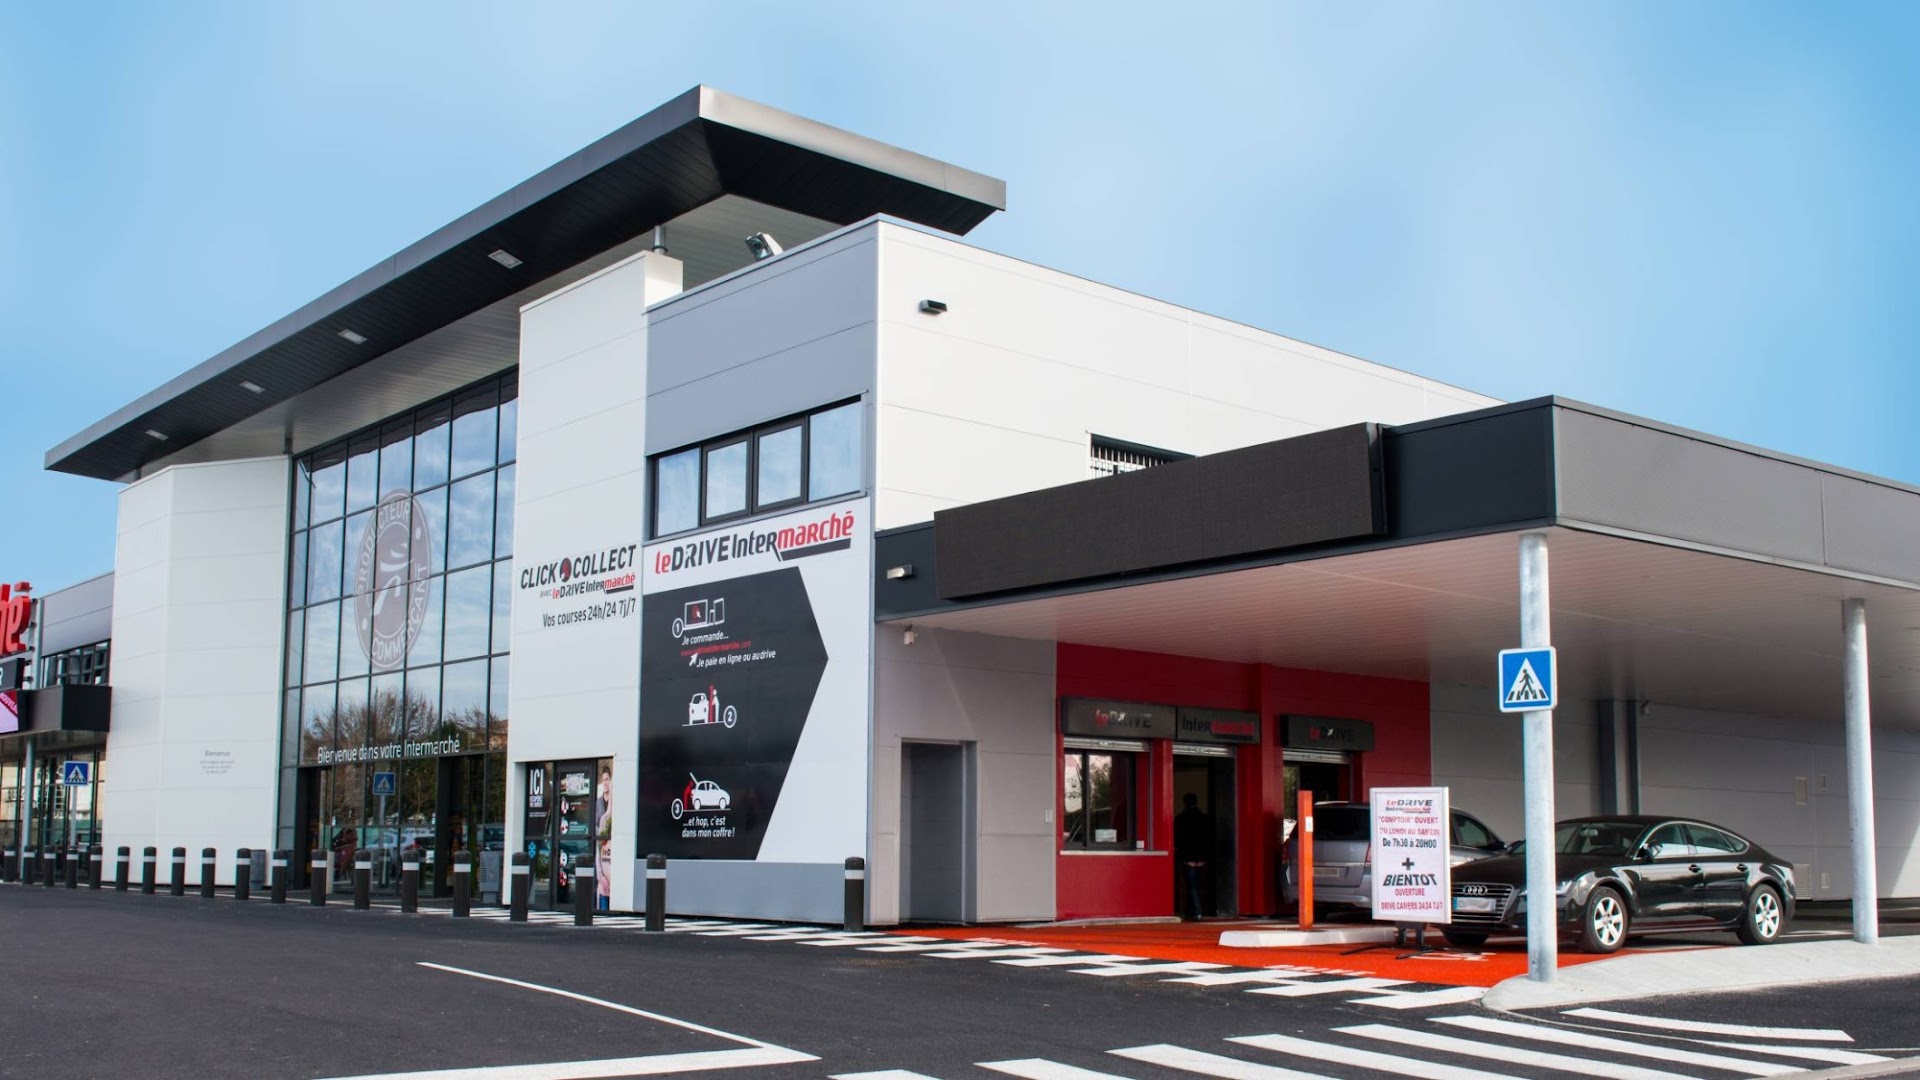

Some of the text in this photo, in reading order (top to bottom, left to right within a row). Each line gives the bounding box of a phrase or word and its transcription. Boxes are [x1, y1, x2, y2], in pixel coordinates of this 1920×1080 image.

[521, 544, 637, 589] CLICK COLLECT
[539, 589, 552, 598] avec
[543, 597, 637, 627] Vos courses 24h/24 7j/7
[681, 636, 689, 646] Je
[696, 658, 704, 668] Je
[705, 656, 718, 668] paie
[719, 656, 726, 664] en
[727, 653, 742, 665] ligne
[743, 653, 751, 662] ou
[358, 743, 379, 760] dans
[380, 742, 402, 759] votre
[403, 733, 460, 757] Intermarché
[529, 768, 544, 795] ICI
[682, 828, 697, 838] dans
[698, 829, 711, 837] mon
[1382, 838, 1391, 847] De
[1383, 873, 1438, 887] BIENTOT
